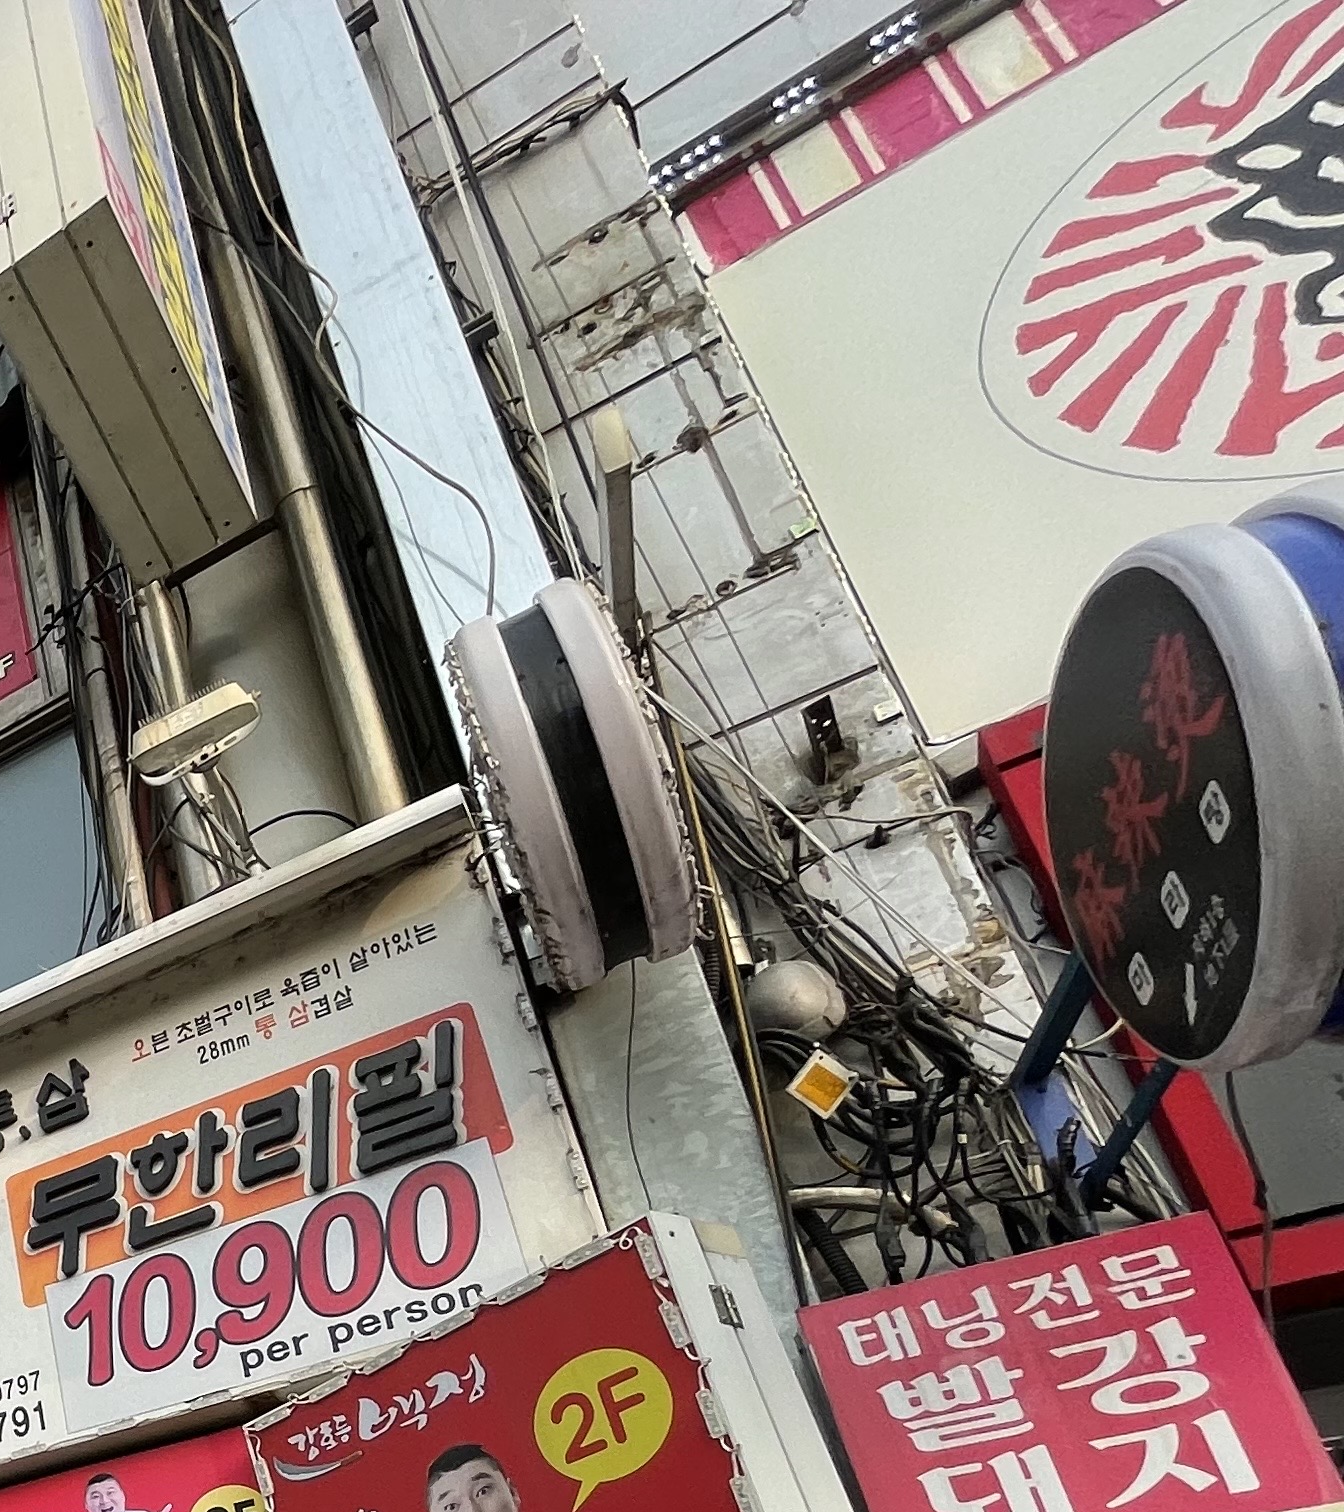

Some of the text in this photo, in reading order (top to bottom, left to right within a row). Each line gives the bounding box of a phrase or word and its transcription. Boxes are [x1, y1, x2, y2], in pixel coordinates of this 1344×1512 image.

[130, 921, 438, 1063] 오븐 초벌구이로 육즙이 살아있는
[197, 984, 355, 1066] 28mm 통 삼겹살
[23, 1016, 464, 1280] 무한리필
[62, 1157, 482, 1390] 10,900
[239, 1281, 486, 1377] per person
[837, 1242, 1198, 1370] 태닝전문
[287, 1353, 487, 1462] 강호동 백정
[550, 1366, 649, 1466] 2F
[875, 1315, 1216, 1455] 빨강
